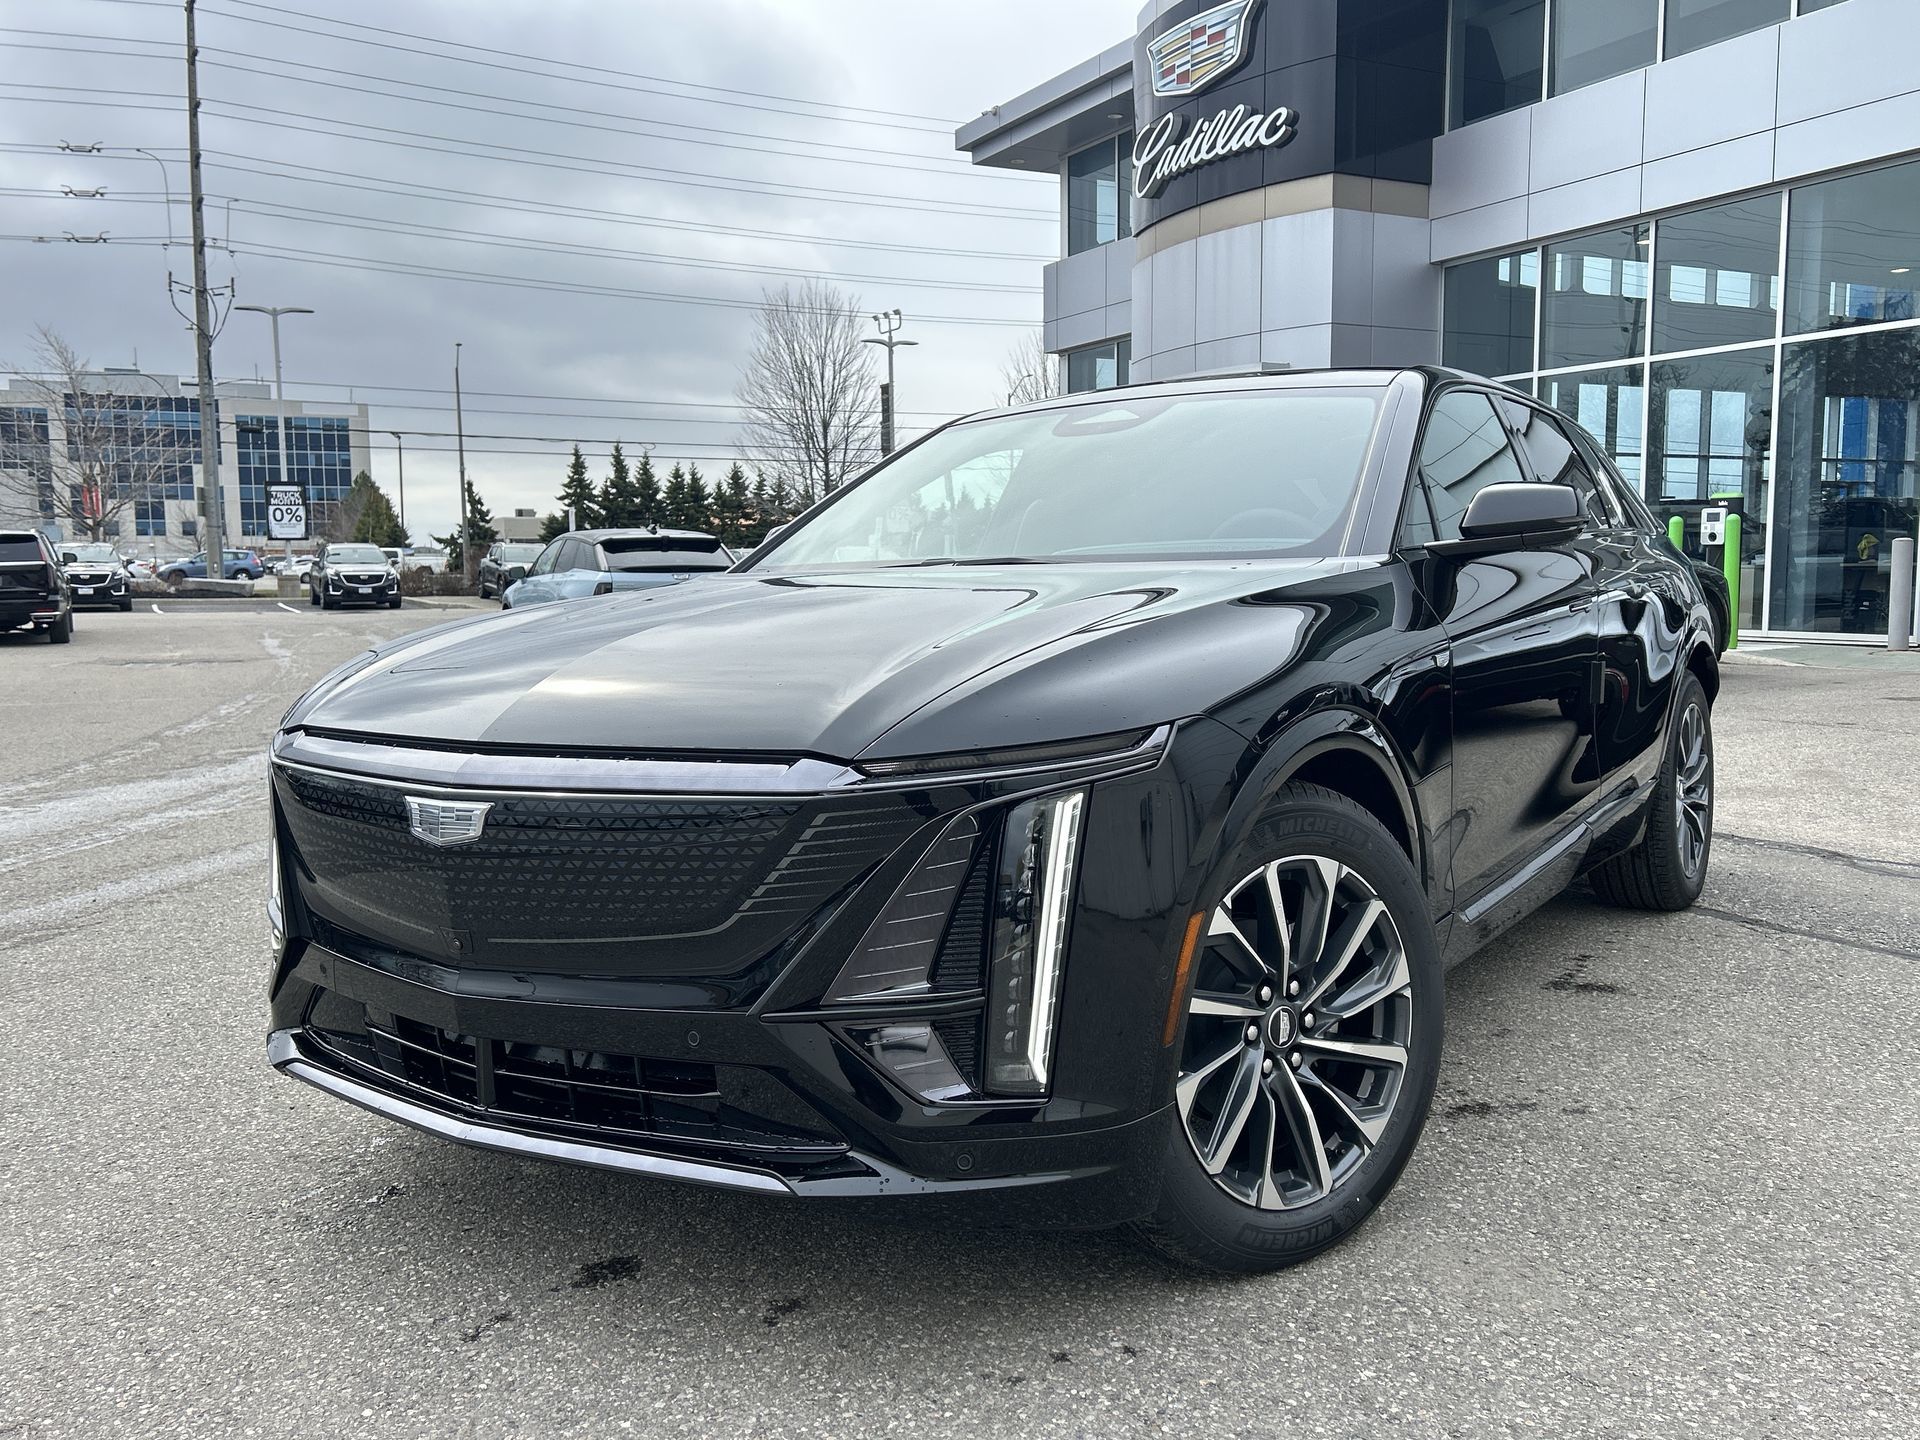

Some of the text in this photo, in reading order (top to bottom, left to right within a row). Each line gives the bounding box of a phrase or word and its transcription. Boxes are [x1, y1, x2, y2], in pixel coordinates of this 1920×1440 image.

[1132, 104, 1290, 198] Cadillac
[273, 507, 302, 522] 0%
[1279, 817, 1368, 846] MICHELIN
[1240, 1221, 1333, 1248] MICHELIN
